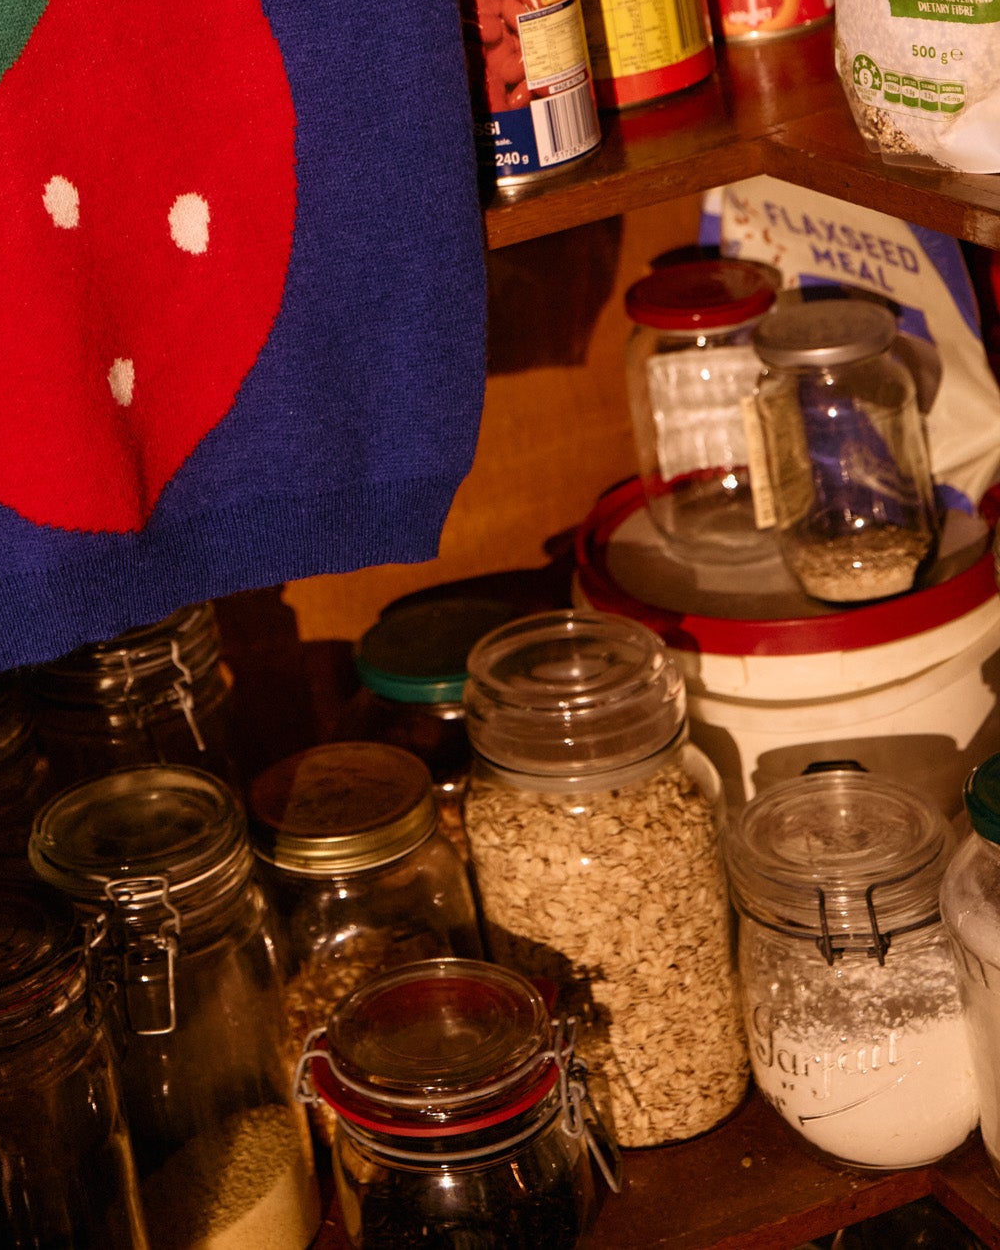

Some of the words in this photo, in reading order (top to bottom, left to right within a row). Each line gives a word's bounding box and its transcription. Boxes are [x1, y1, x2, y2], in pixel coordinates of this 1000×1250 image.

[917, 1, 951, 14] DIETARY
[951, 4, 975, 17] FIBRE
[912, 44, 937, 59] 500
[940, 52, 949, 65] g
[863, 72, 869, 85] 5
[495, 151, 520, 167] 240
[521, 154, 530, 165] g
[764, 200, 920, 275] FLAXSEED
[811, 242, 895, 293] MEAL
